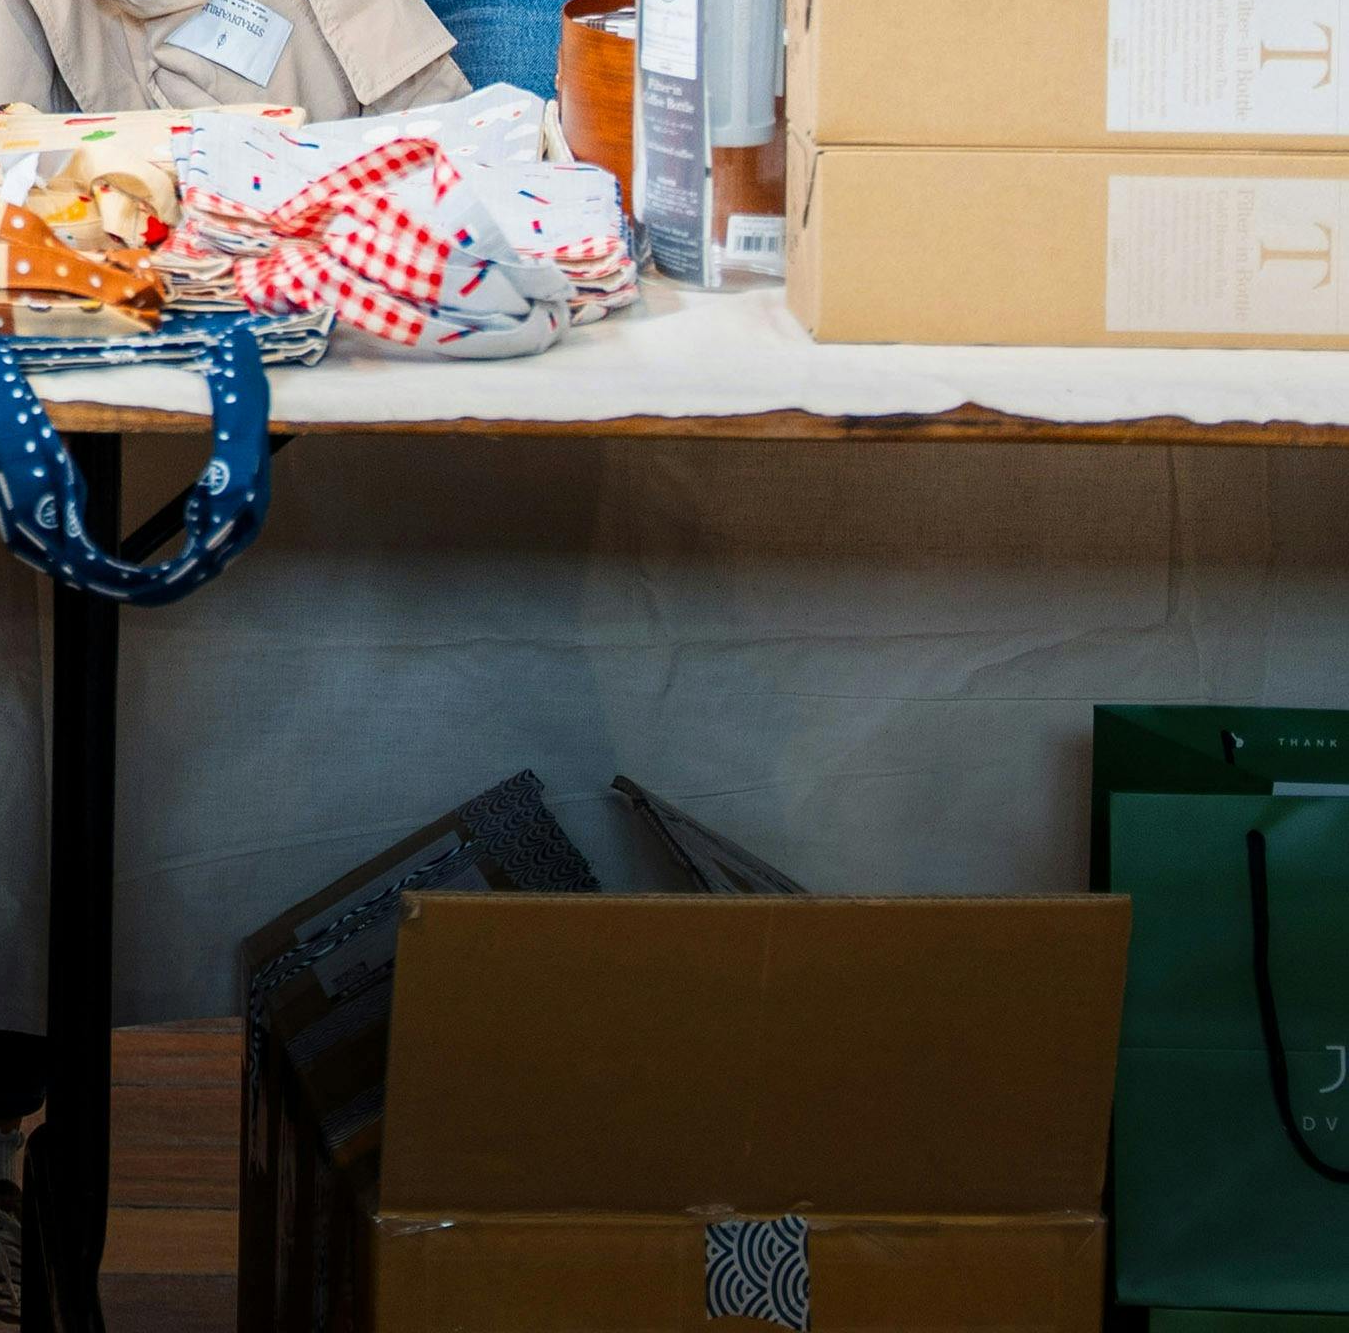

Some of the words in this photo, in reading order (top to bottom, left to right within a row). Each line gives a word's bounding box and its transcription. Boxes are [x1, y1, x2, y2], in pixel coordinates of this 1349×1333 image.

[1260, 21, 1332, 89] T
[1235, 69, 1254, 122] Bottle
[1260, 221, 1332, 290] T
[1234, 269, 1255, 323] Bottle
[1278, 738, 1337, 748] THANK
